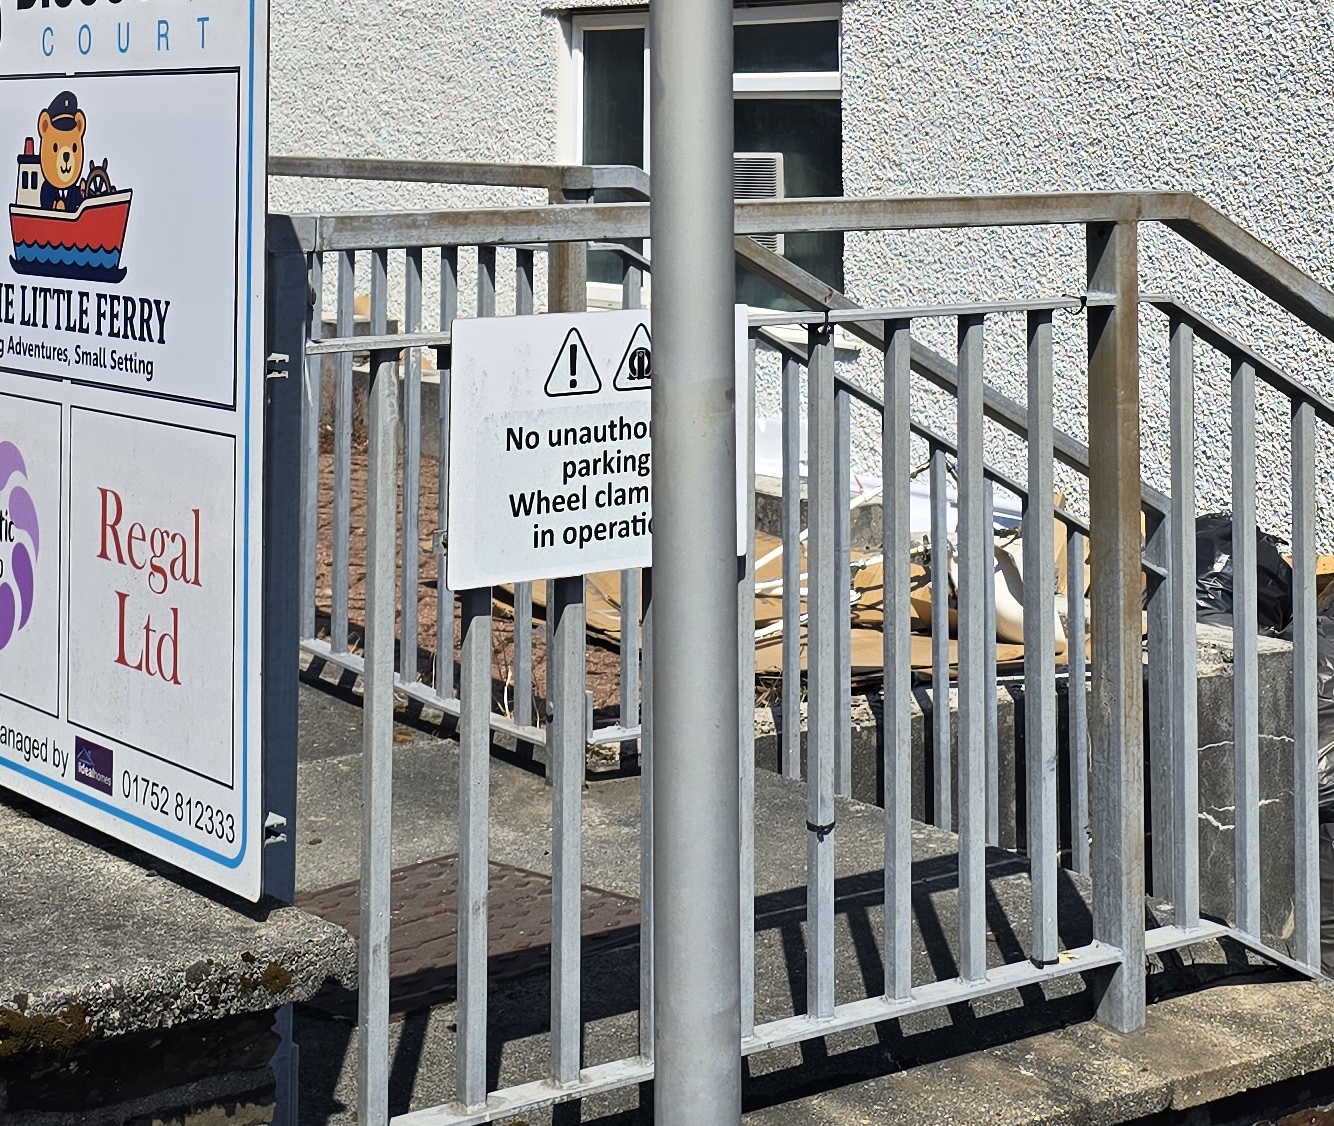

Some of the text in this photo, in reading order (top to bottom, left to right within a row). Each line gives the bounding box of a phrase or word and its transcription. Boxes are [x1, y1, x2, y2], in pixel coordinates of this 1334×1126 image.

[42, 17, 209, 56] COURT
[19, 285, 90, 334] LITTLE
[95, 292, 171, 344] FERRY
[7, 335, 71, 367] Adventures,
[75, 344, 107, 369] Small
[110, 349, 154, 382] Setting
[506, 416, 652, 452] No unautho
[563, 449, 651, 486] parking
[509, 482, 650, 518] Wheel clam
[97, 487, 203, 594] Regal
[533, 511, 653, 550] in operati
[114, 590, 182, 685] Ltd
[52, 739, 69, 778] by
[122, 770, 236, 844] 01752 812333
